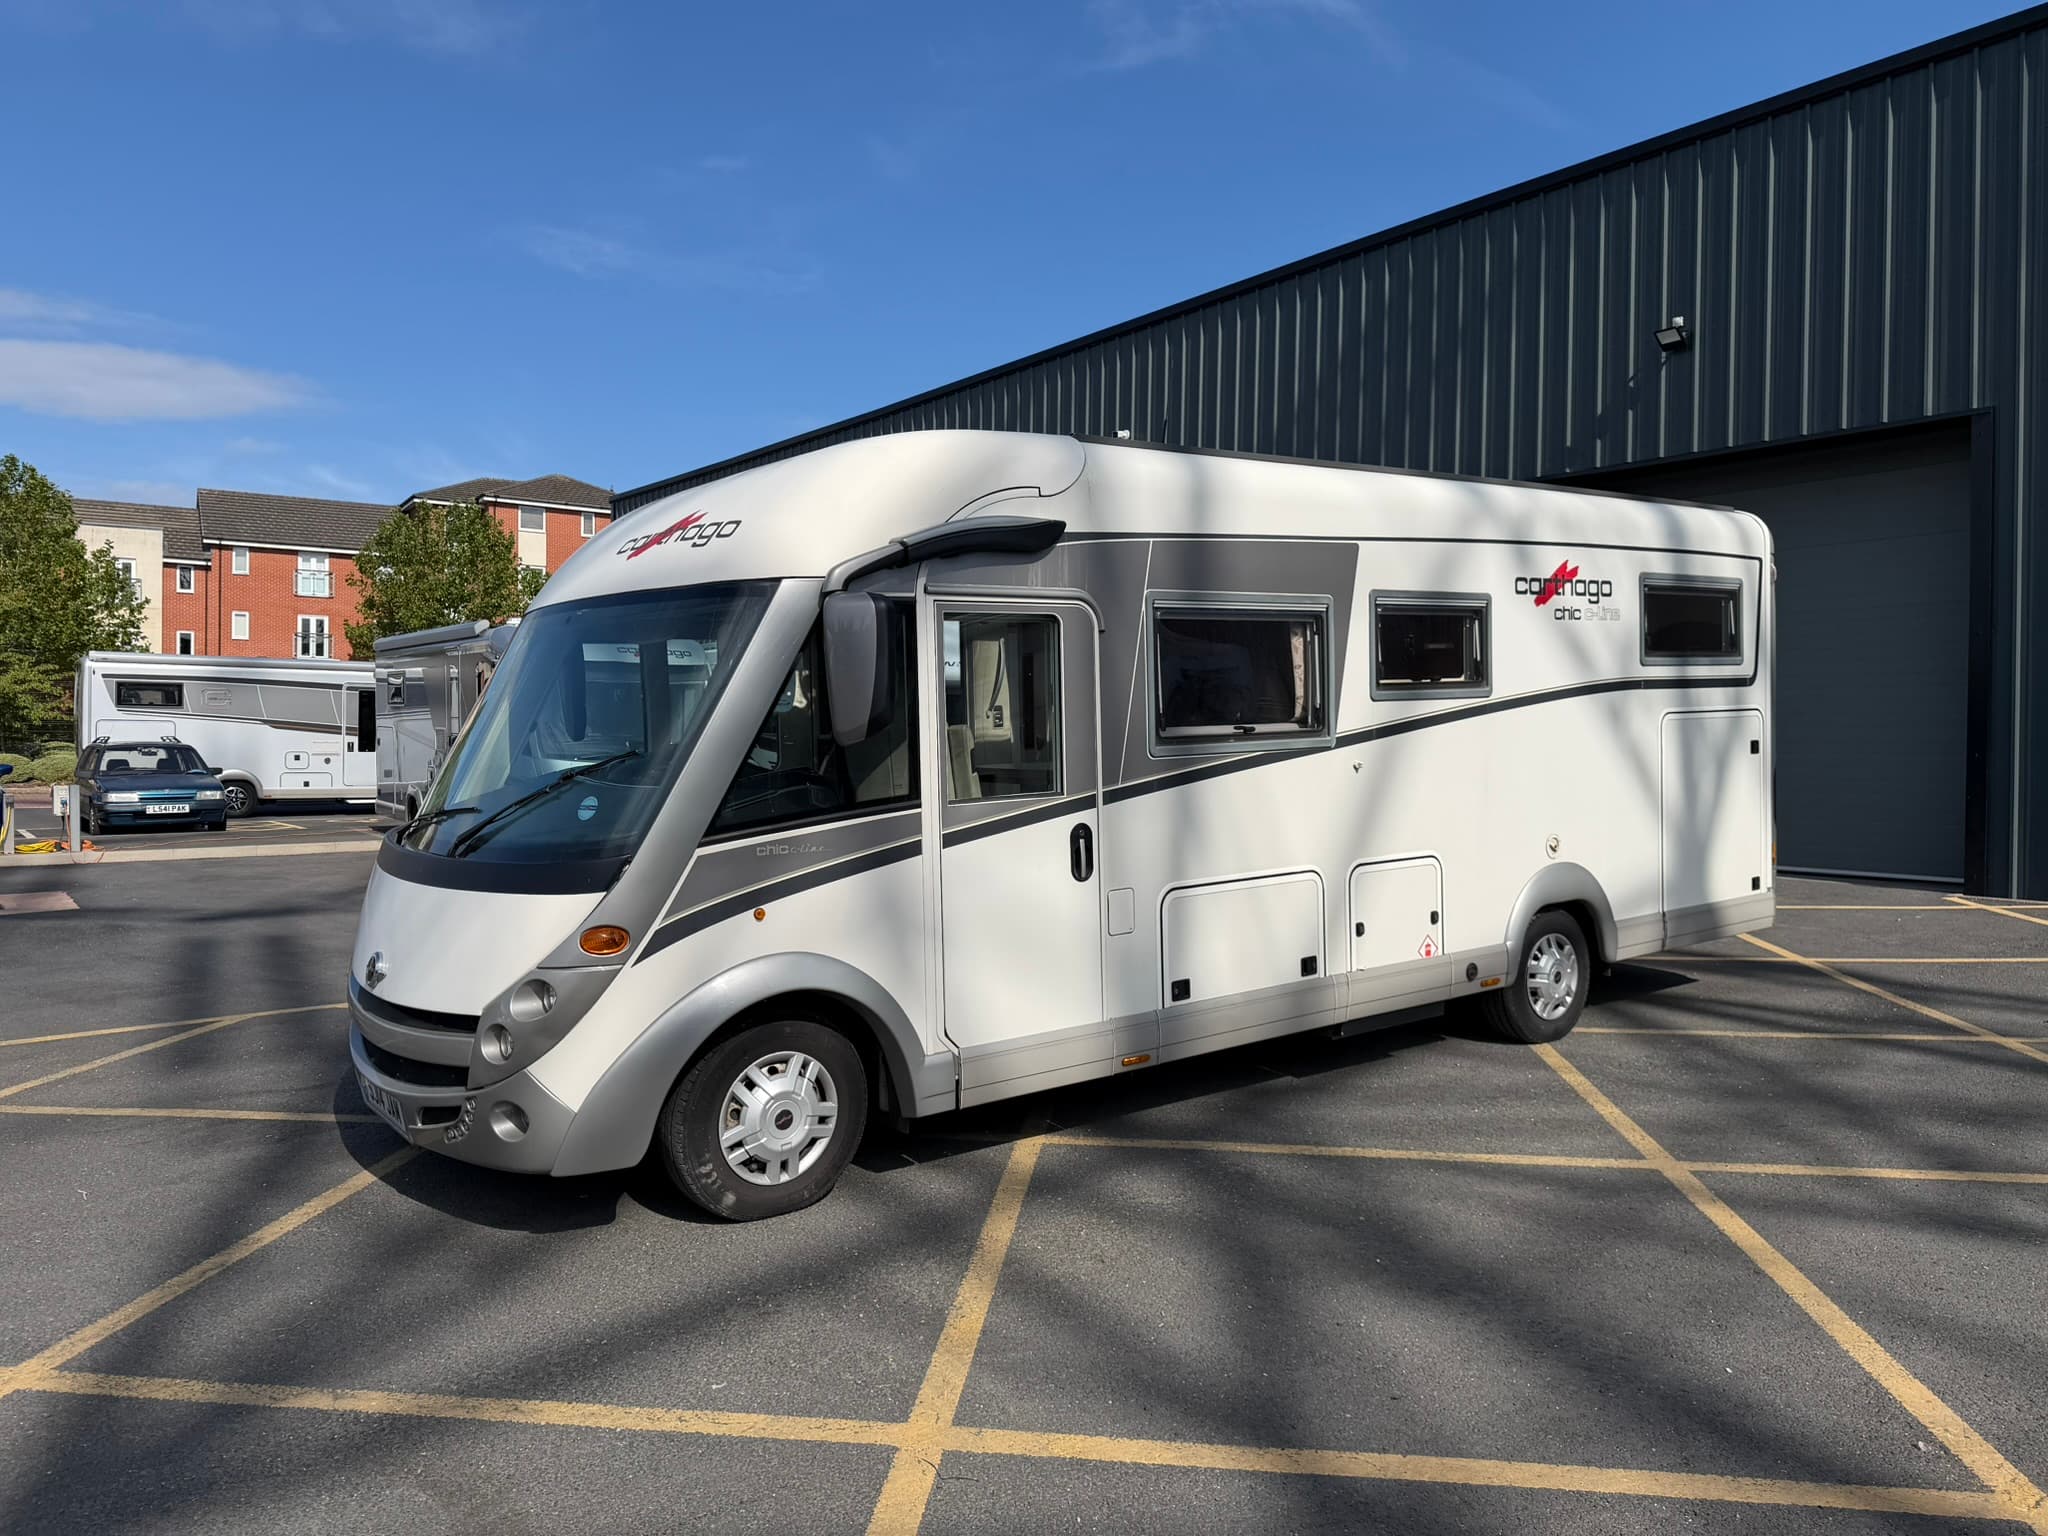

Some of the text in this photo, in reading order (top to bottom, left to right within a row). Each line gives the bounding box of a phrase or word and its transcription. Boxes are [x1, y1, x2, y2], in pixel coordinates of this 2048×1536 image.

[1515, 572, 1613, 604] carthago
[1554, 606, 1582, 620] chic
[756, 843, 789, 856] chic
